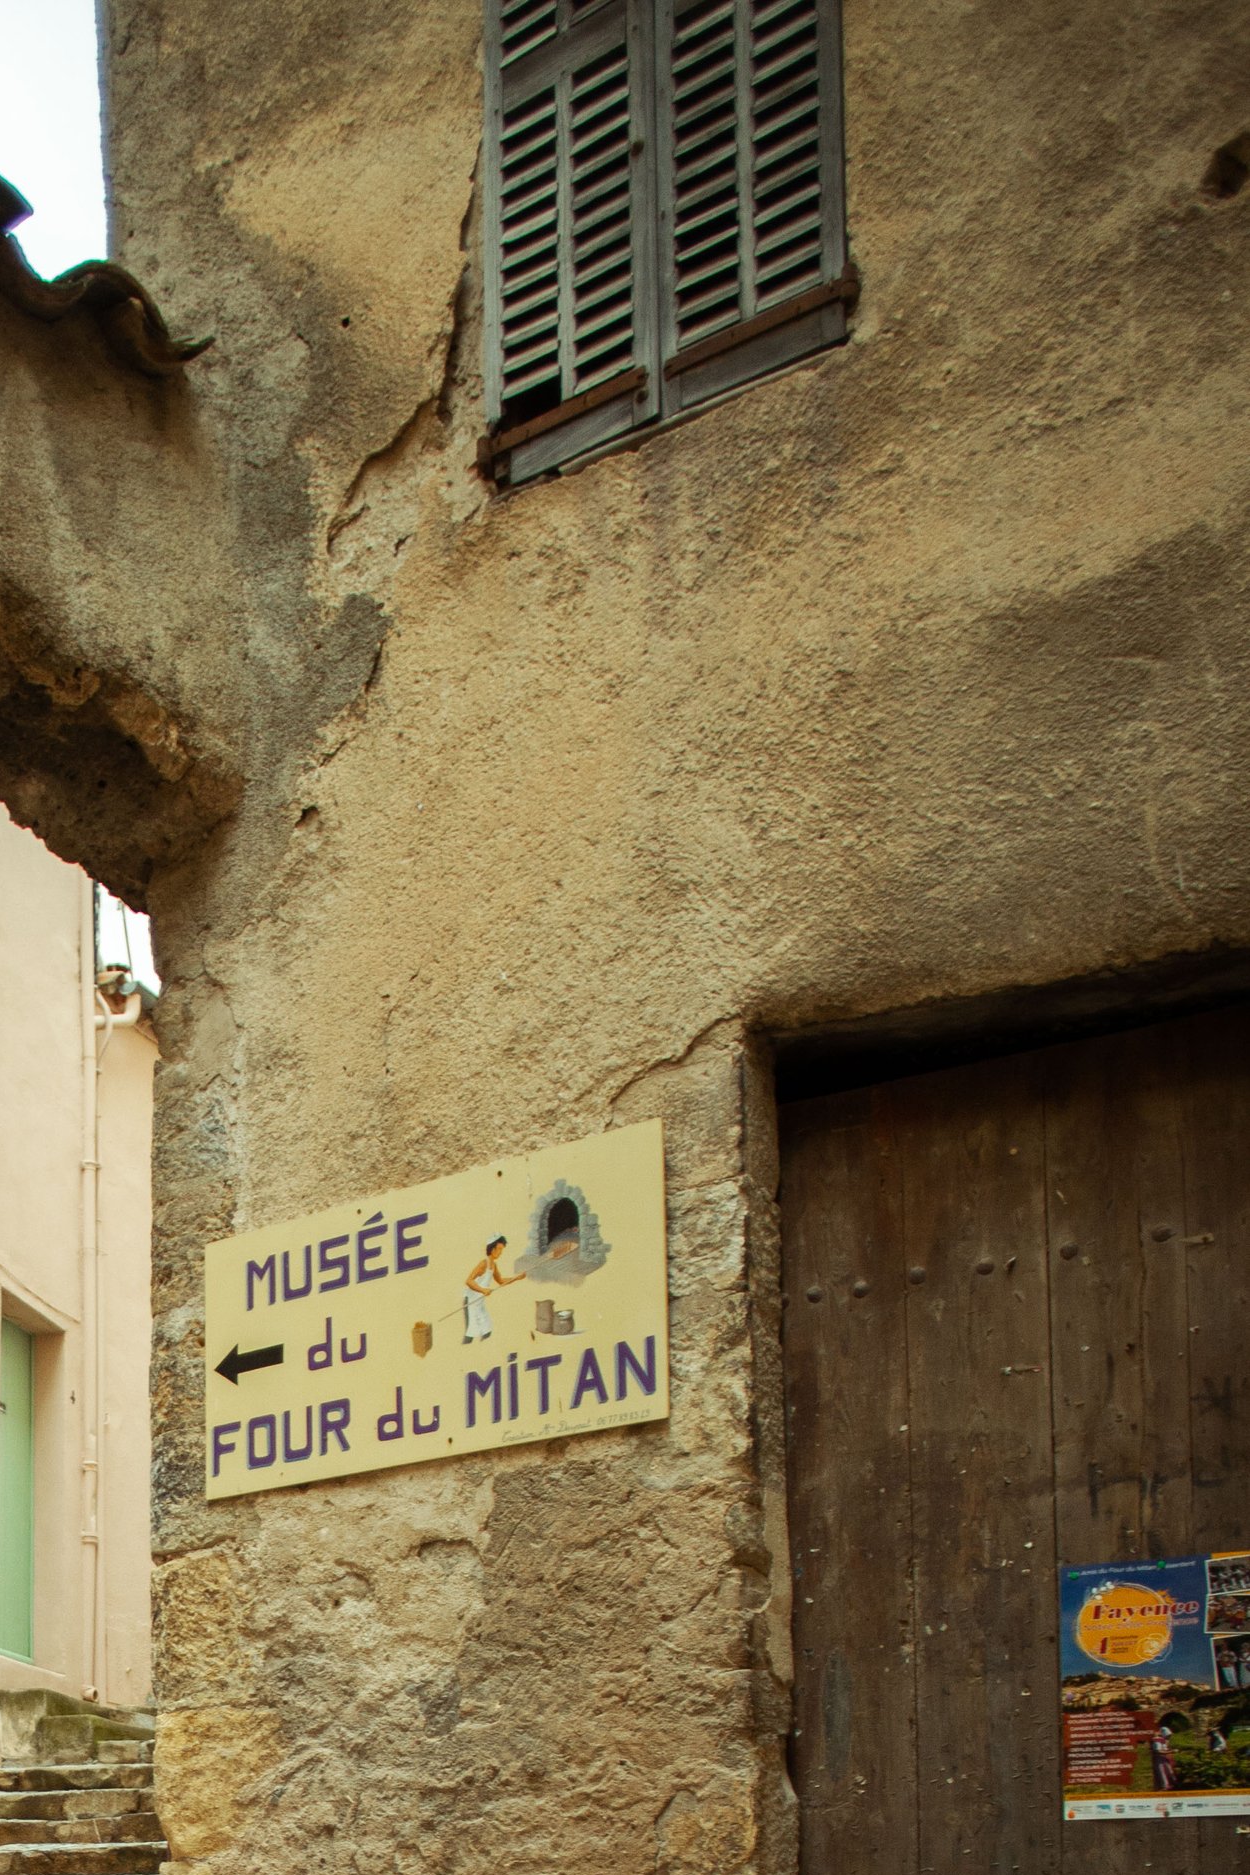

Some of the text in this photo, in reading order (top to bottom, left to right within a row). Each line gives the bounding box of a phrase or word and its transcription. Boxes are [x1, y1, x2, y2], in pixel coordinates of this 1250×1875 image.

[246, 1212, 429, 1311] MUSÉE
[307, 1317, 367, 1372] du
[212, 1398, 351, 1477] FOUR
[377, 1386, 440, 1442] du
[1093, 1600, 1199, 1622] Fayence
